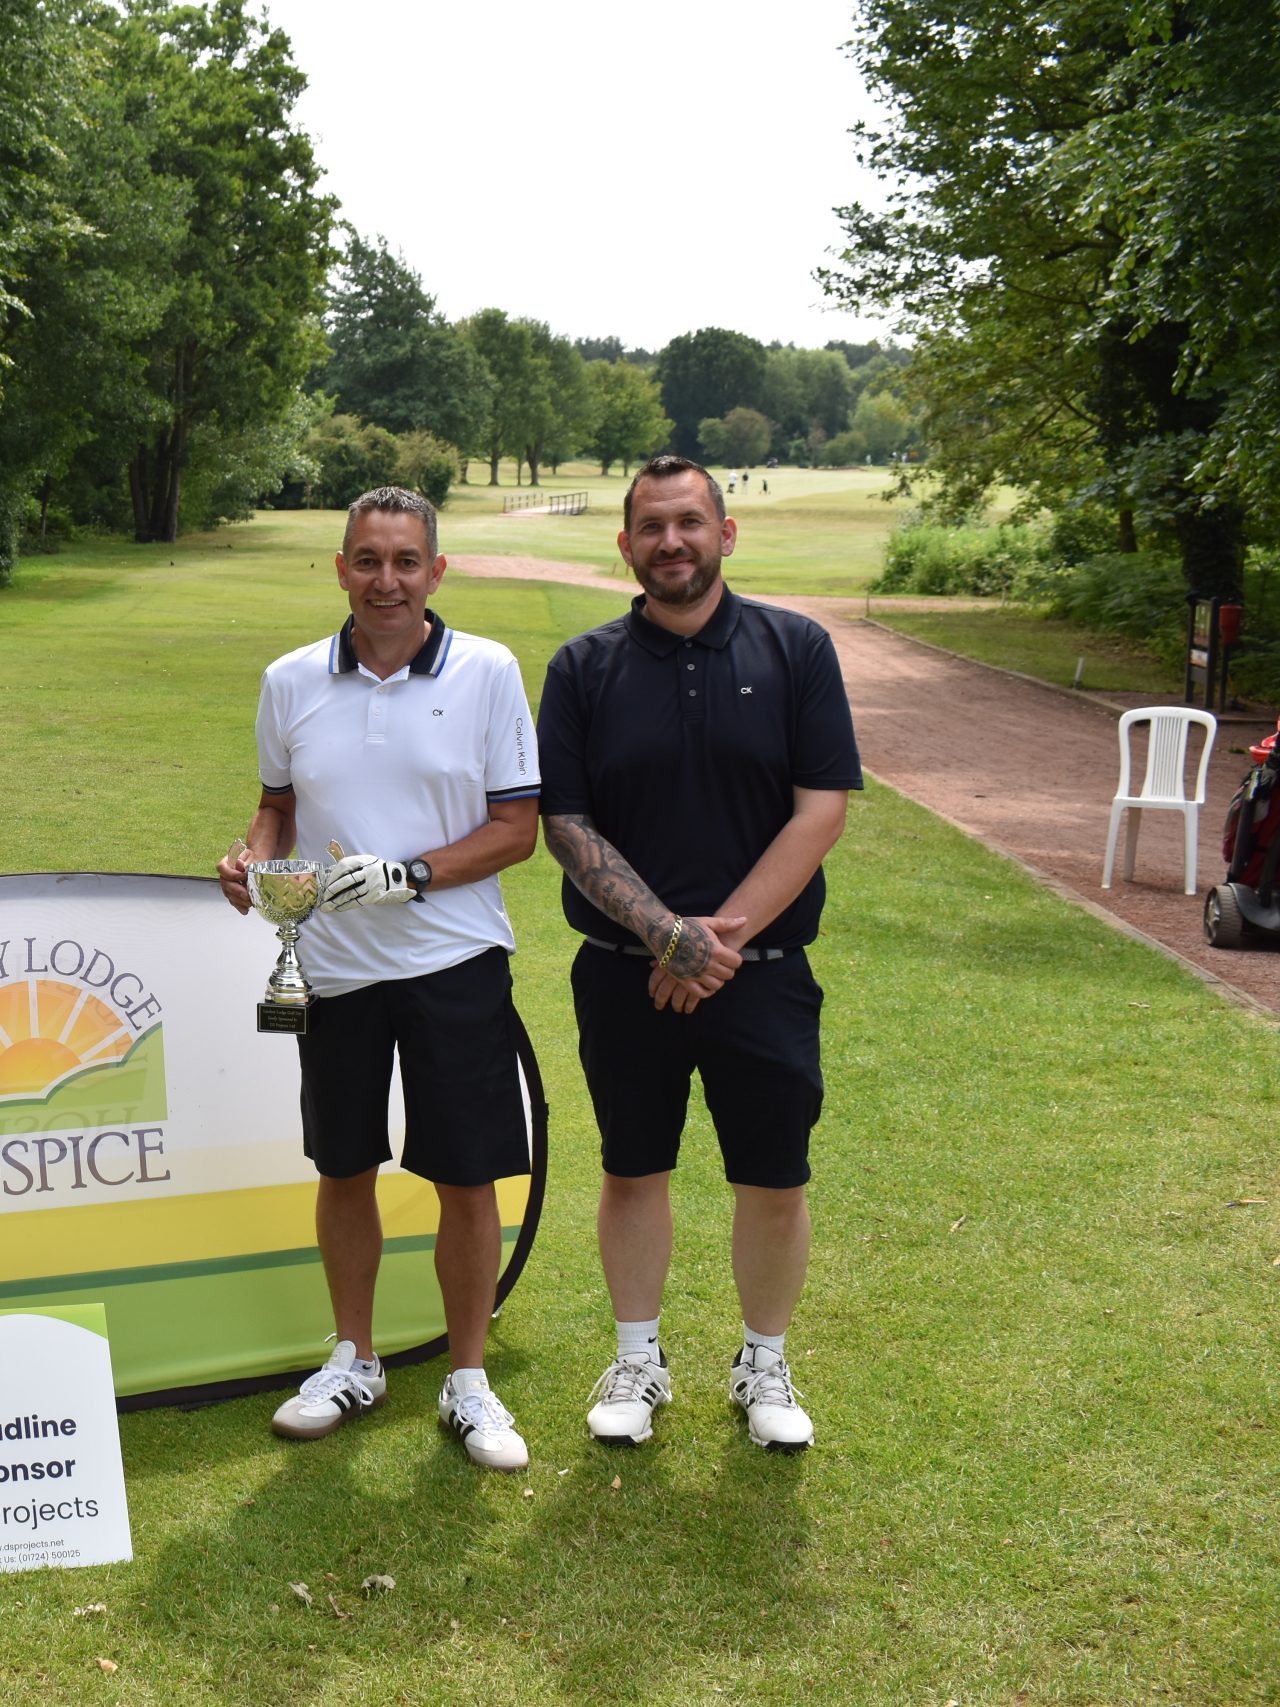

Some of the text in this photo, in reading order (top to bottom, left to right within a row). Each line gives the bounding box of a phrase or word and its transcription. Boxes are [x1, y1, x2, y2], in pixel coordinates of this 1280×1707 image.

[515, 717, 527, 776] Calvin Klein
[23, 937, 163, 1031] LODGE
[3, 1555, 17, 1563] Us:
[18, 1550, 49, 1564] (01724)
[51, 1549, 81, 1559] 500125
